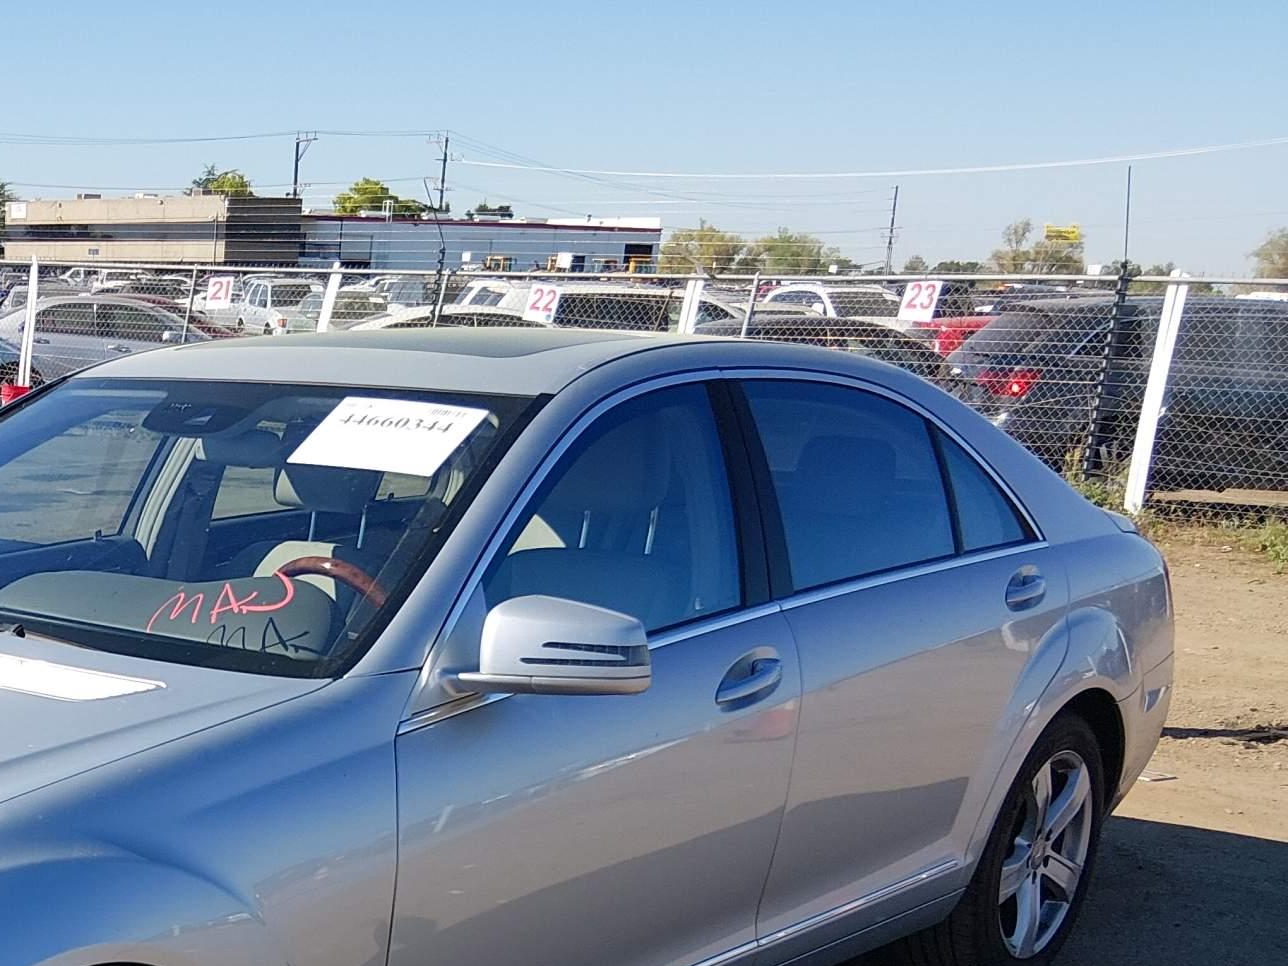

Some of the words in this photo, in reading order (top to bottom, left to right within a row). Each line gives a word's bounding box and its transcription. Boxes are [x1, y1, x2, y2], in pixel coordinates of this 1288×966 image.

[209, 280, 231, 300] 21
[529, 288, 557, 312] 22
[904, 283, 937, 310] 23
[339, 413, 454, 433] 44660344
